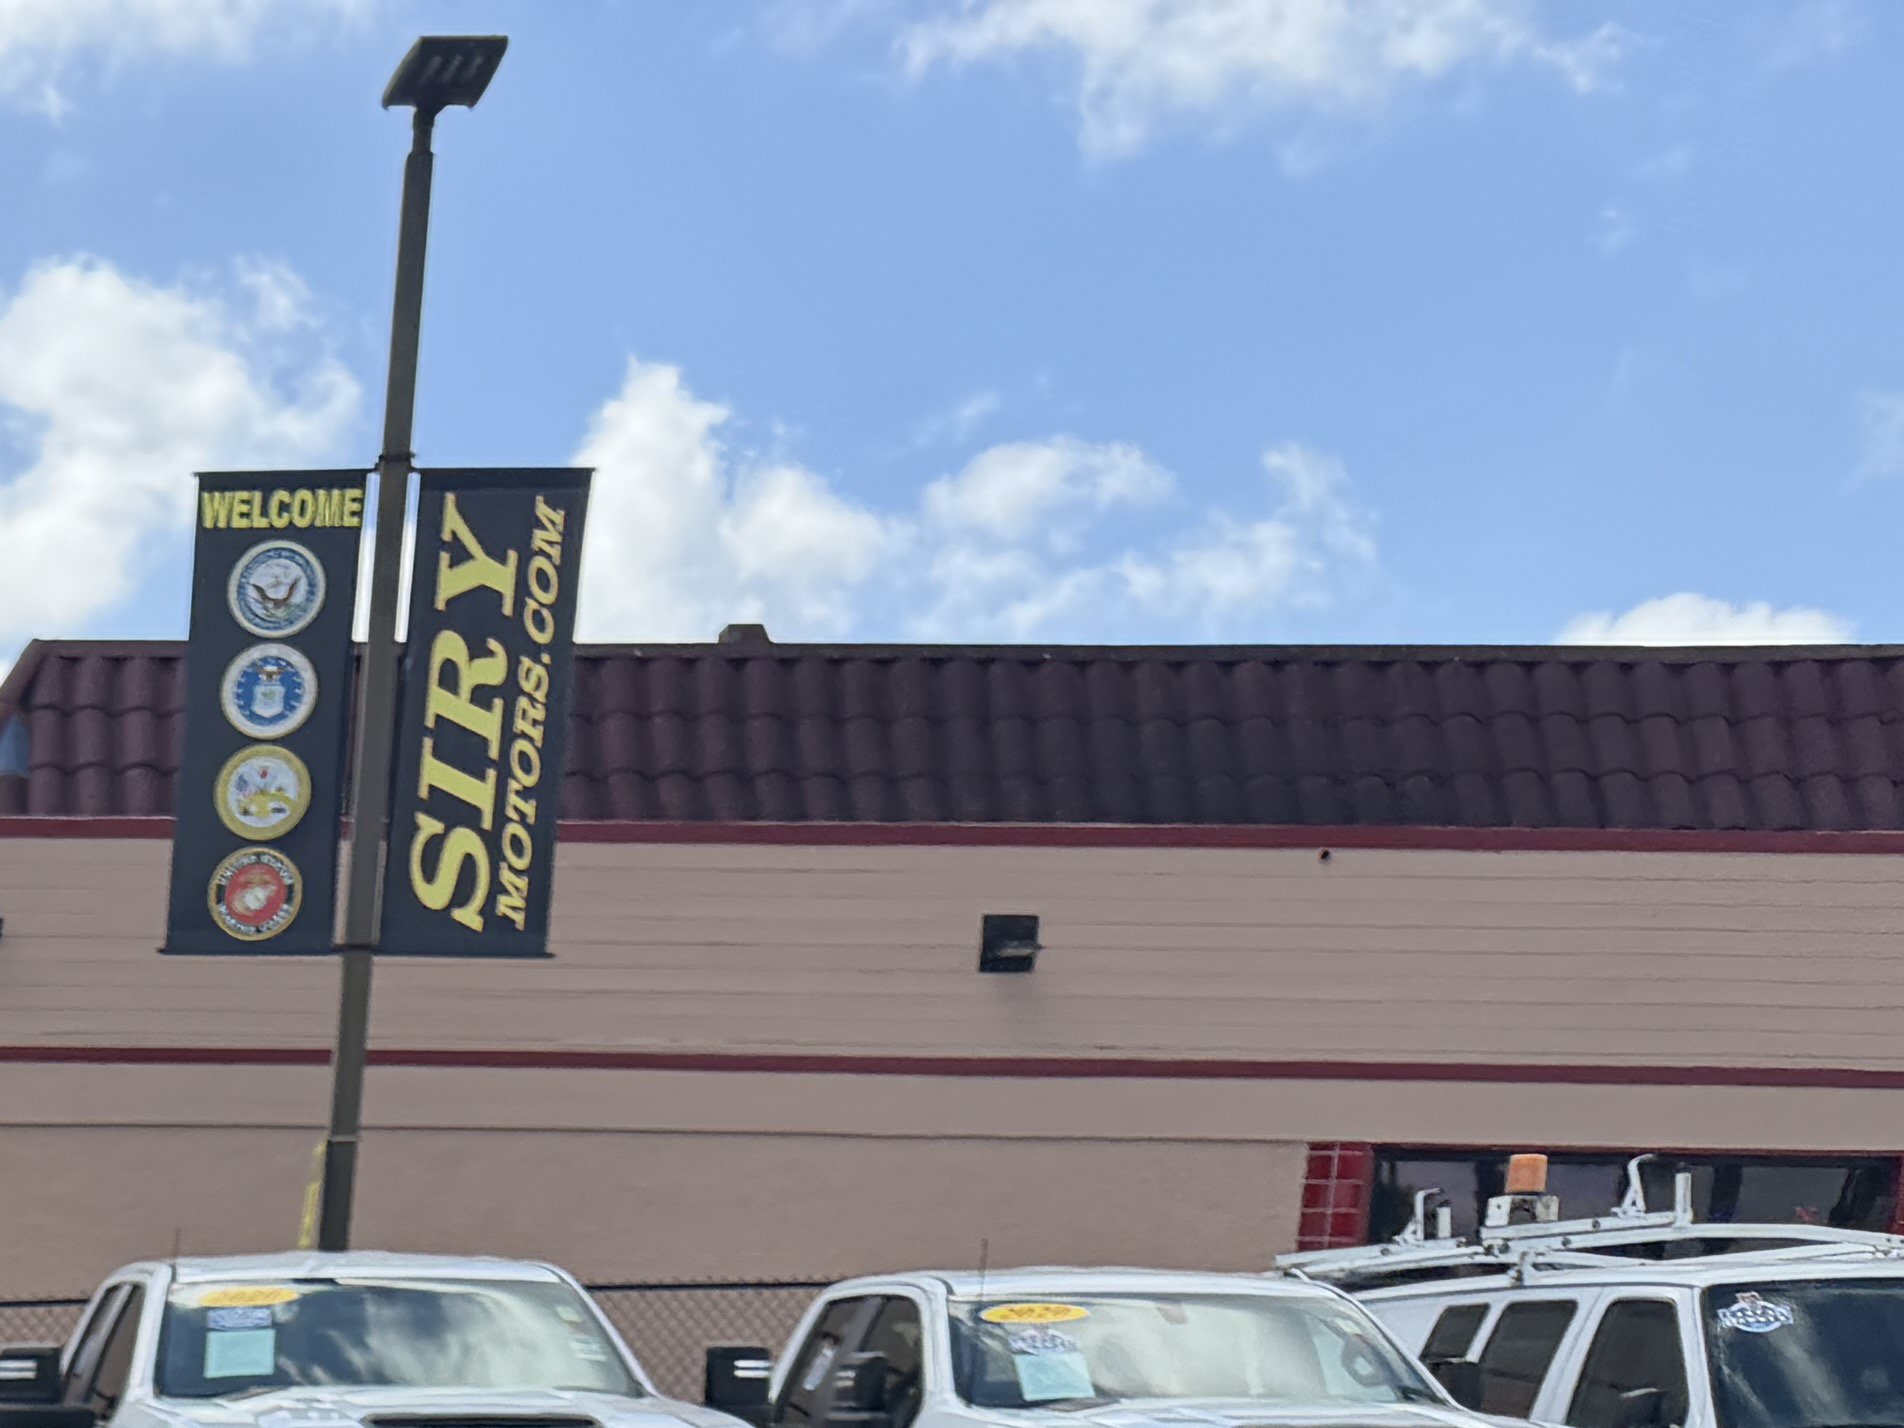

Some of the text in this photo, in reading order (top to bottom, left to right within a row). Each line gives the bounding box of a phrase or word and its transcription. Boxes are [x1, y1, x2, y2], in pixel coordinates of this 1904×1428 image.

[201, 488, 364, 529] WELCOME
[410, 492, 517, 933] SIRY
[496, 496, 566, 930] MOTORS.COM
